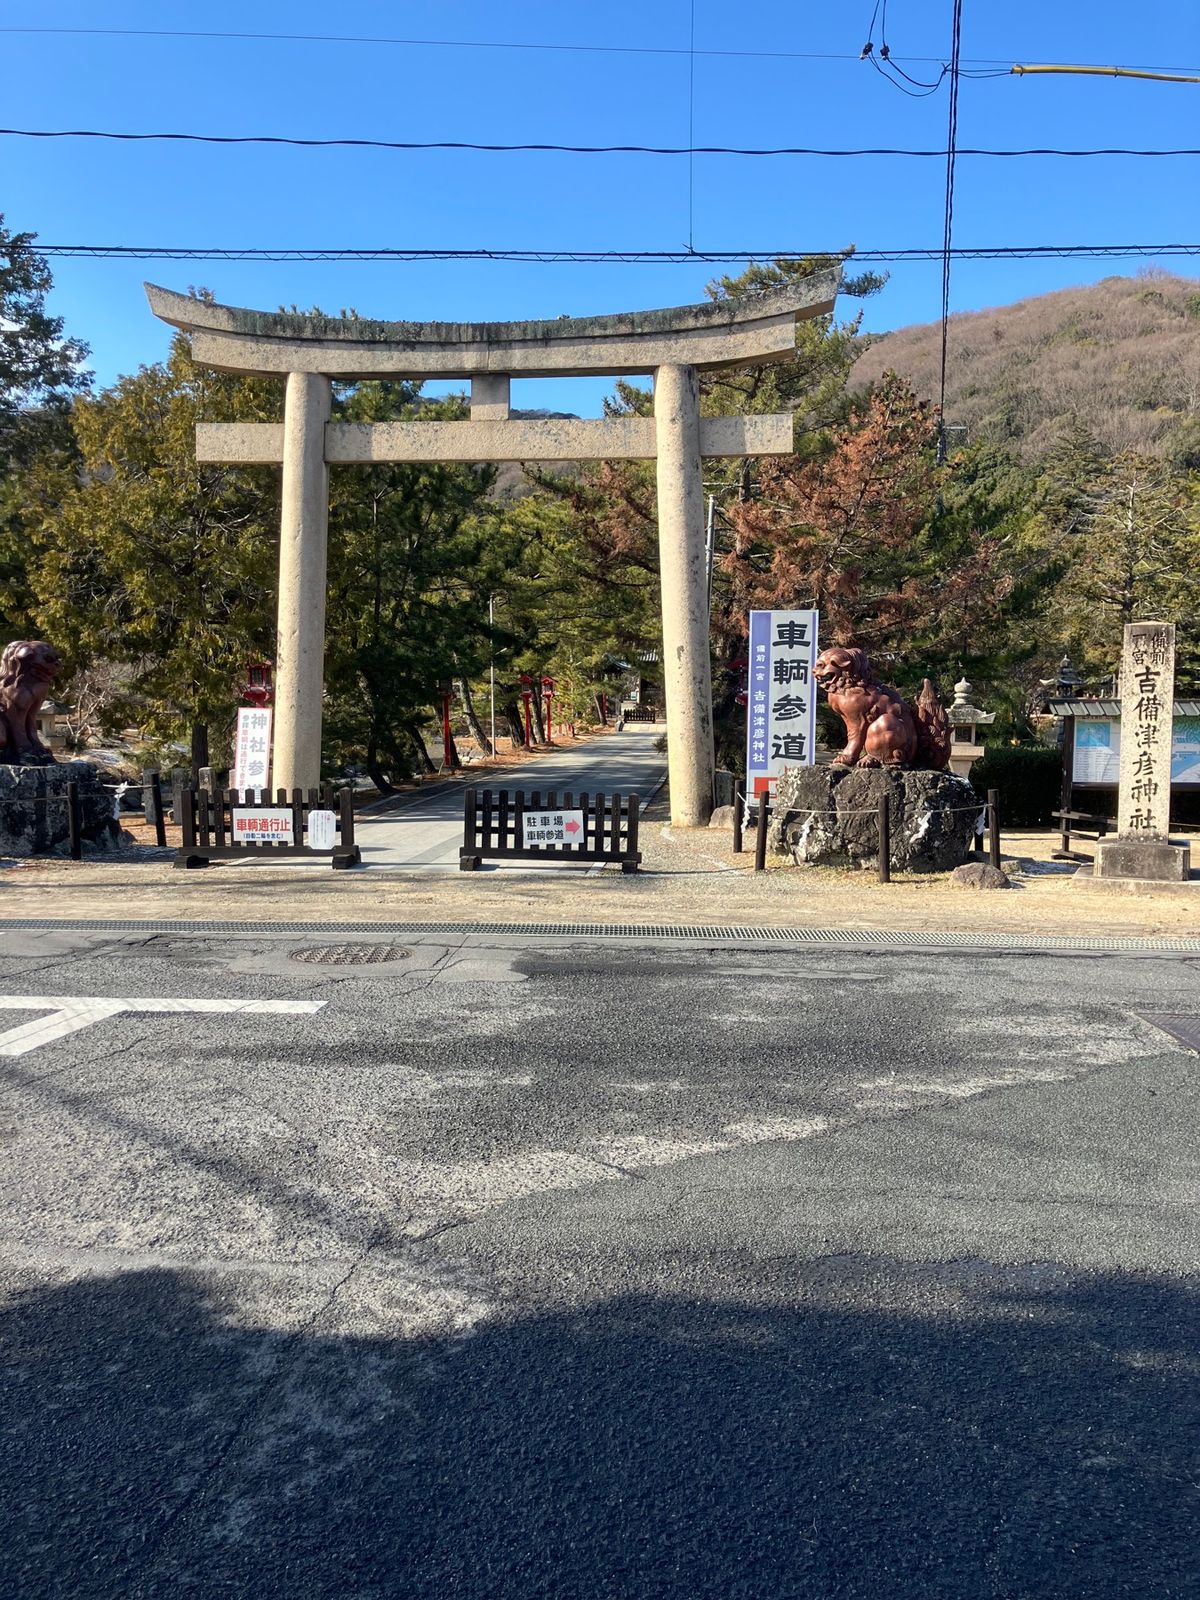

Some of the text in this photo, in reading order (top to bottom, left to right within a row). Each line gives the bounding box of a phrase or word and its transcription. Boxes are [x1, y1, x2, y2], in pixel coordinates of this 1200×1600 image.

[752, 644, 767, 763] 備前一宮 吉備津彦神社
[771, 619, 811, 761] 車輌参道
[1129, 666, 1164, 830] 吉備津彦神社
[526, 815, 564, 828] 駐車場
[526, 829, 564, 841] 車輌参道
